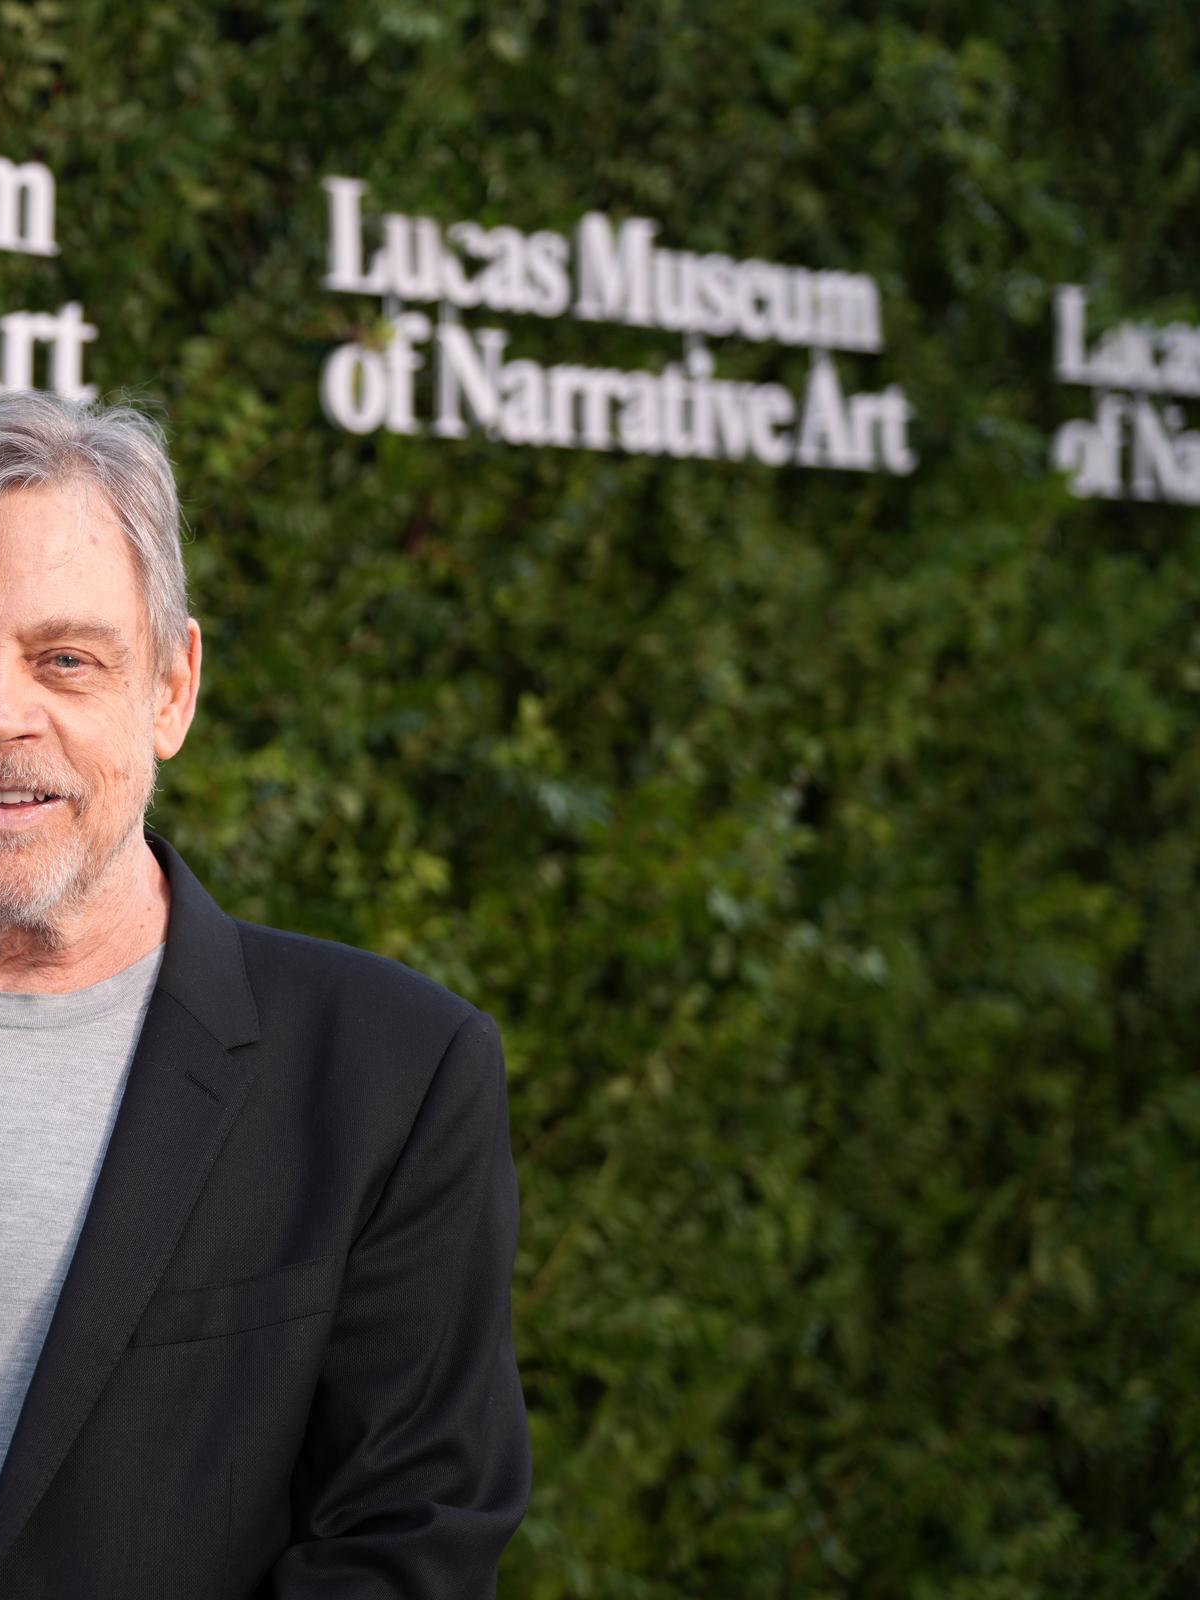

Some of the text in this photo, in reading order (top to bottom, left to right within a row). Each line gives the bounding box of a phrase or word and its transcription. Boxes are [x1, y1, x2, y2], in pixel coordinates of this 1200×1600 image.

[323, 177, 883, 352] Lucas Museum
[321, 314, 917, 473] of Narrative Art
